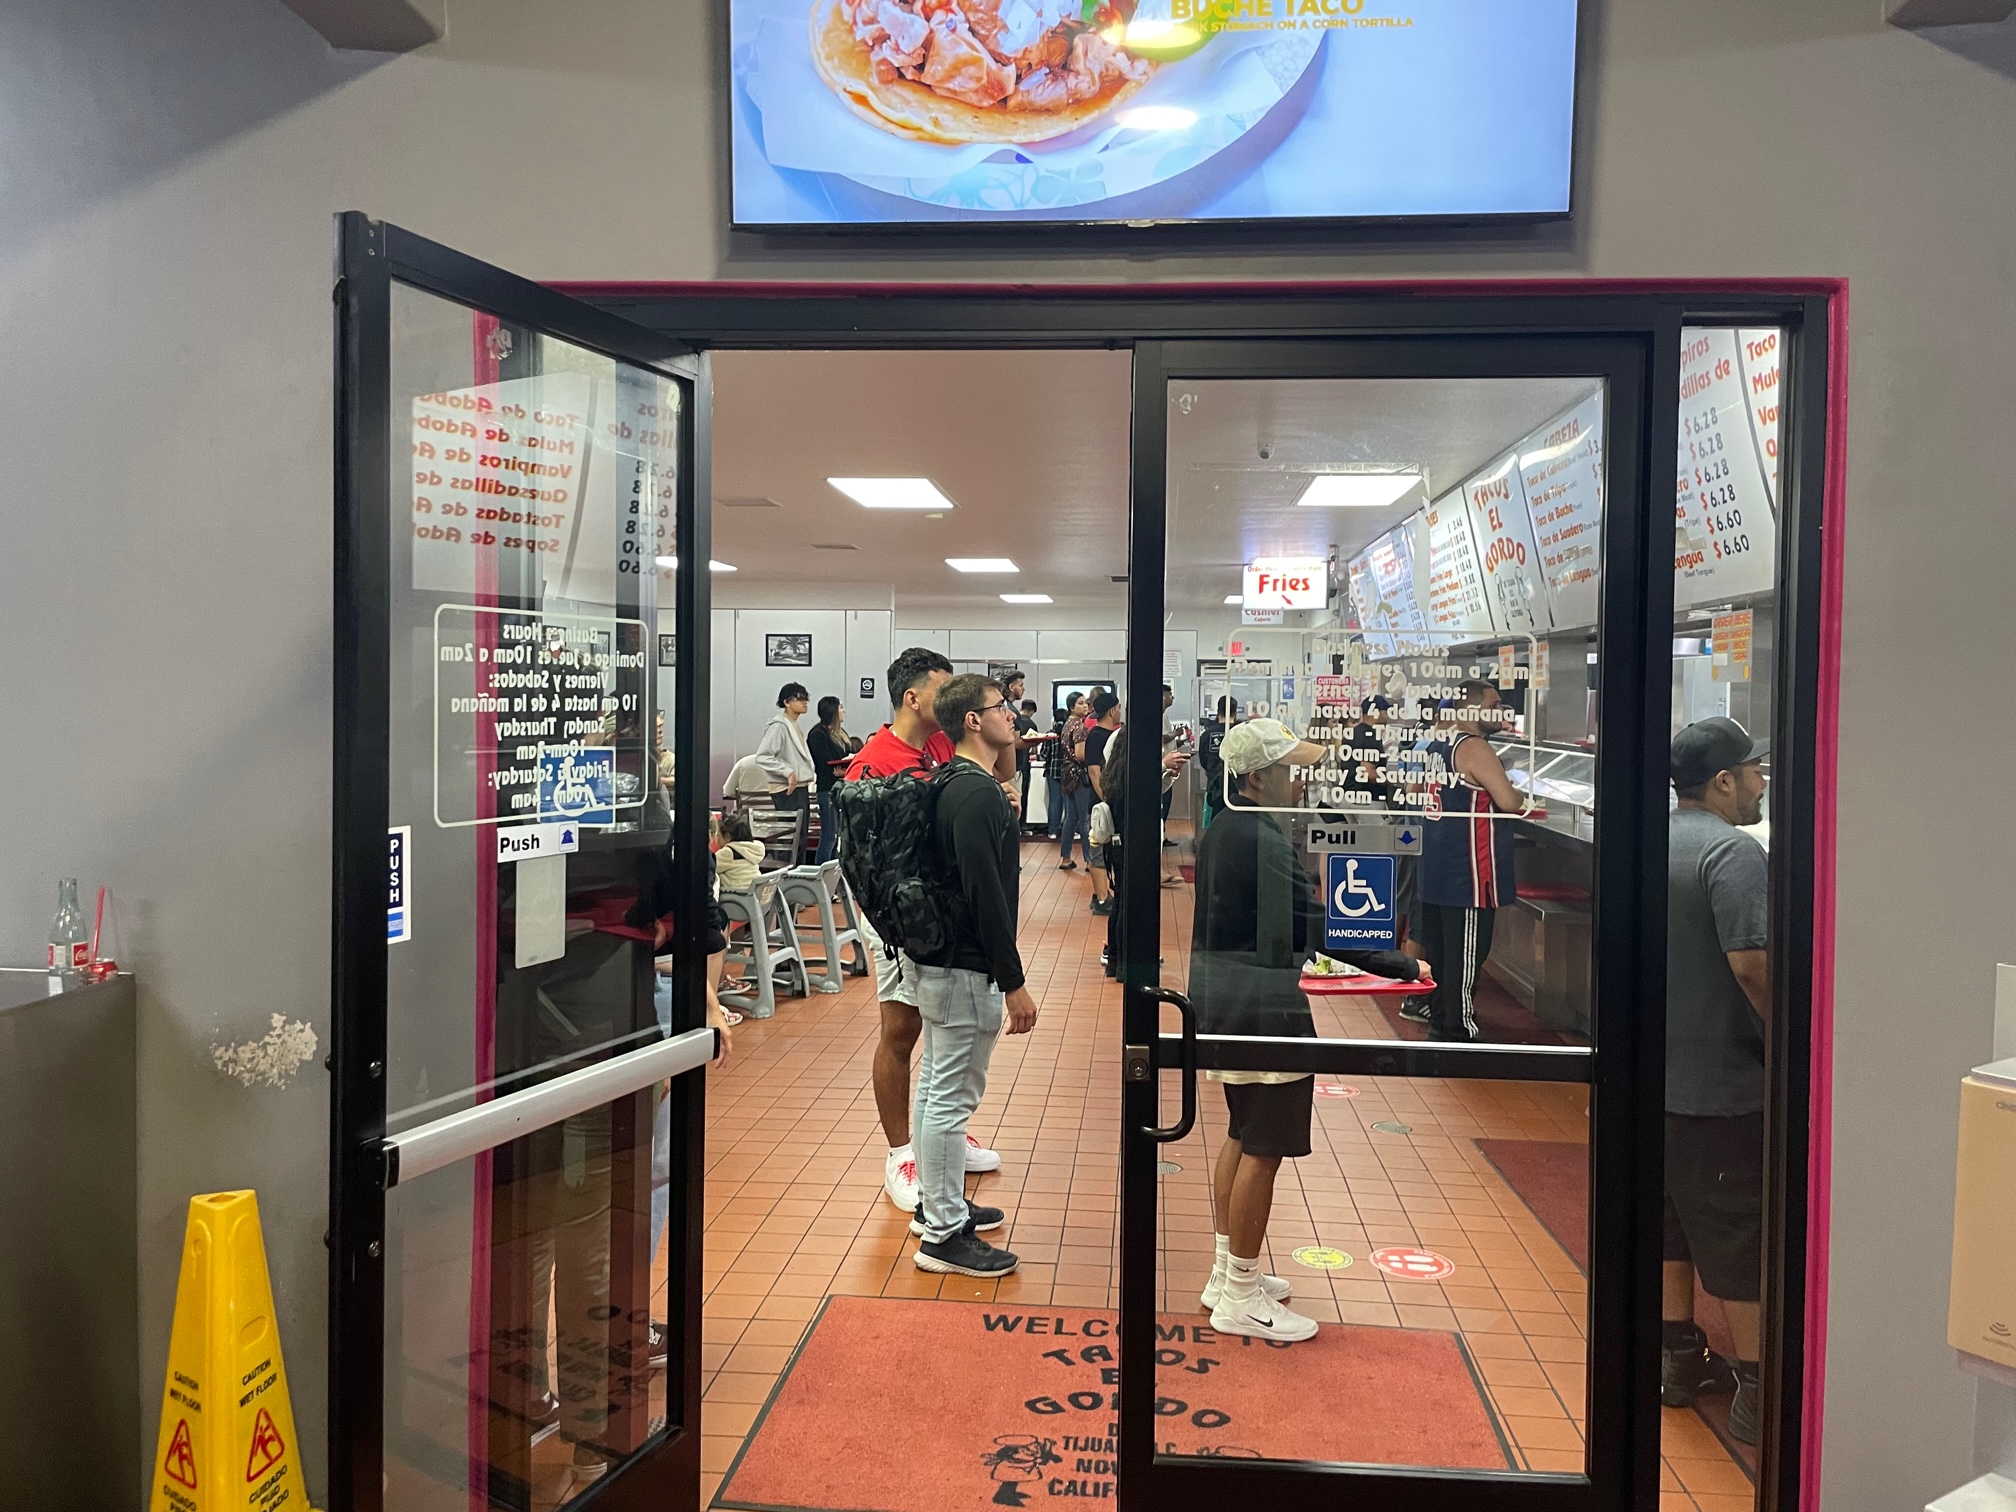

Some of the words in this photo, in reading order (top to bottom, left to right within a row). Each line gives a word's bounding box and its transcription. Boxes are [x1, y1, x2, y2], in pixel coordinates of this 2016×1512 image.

[1171, 0, 1275, 18] BUCHE
[1284, 0, 1365, 17] TACO
[1211, 20, 1274, 32] STOMACH
[1278, 20, 1297, 31] ON
[1299, 20, 1309, 30] A
[1312, 18, 1349, 29] CORN
[1353, 17, 1414, 28] TORTILLA
[1746, 333, 1777, 362] Taco
[1714, 358, 1731, 381] de
[1693, 406, 1719, 435] 6.28
[1698, 432, 1724, 459] 6.28
[1527, 475, 1539, 488] Taco
[1704, 458, 1730, 483] 6.28
[1474, 476, 1510, 512] TACOS
[1531, 495, 1543, 508] Taco
[1710, 483, 1736, 508] 6.28
[1488, 505, 1503, 533] EL
[1535, 515, 1547, 528] Taco
[1547, 509, 1555, 523] de
[1716, 509, 1742, 532] 6.60
[1540, 535, 1552, 548] Taco
[1551, 530, 1559, 543] de
[1723, 534, 1750, 556] 6.60
[1485, 537, 1527, 577] GORDO
[1544, 555, 1556, 568] Taco
[1556, 551, 1564, 564] de
[1258, 573, 1311, 595] Fries
[1396, 640, 1450, 658] Hours
[1409, 661, 1463, 679] 10am
[1468, 665, 1481, 678] a
[1487, 662, 1530, 680] 2am
[1246, 700, 1271, 718] 10
[1311, 699, 1361, 719] hasta
[1367, 702, 1380, 719] 4
[1415, 703, 1434, 721] la
[1440, 704, 1516, 722] mañana
[1327, 744, 1428, 763] 10am-2am
[1289, 764, 1350, 787] Friday
[1354, 766, 1370, 783] &
[1375, 766, 1467, 789] Saturday:
[1320, 786, 1373, 805] 10am
[1392, 788, 1436, 806] 4am
[499, 833, 541, 854] Push
[1311, 829, 1356, 845] Pull
[389, 838, 400, 904] PUSH
[1328, 929, 1393, 939] HANDICAPPED
[982, 1313, 1217, 1345] WELCME
[1042, 1344, 1221, 1375] TAOS
[242, 1357, 272, 1387] CAUTION
[239, 1388, 255, 1408] WET
[255, 1372, 278, 1396] FLOOR
[248, 1464, 289, 1505] CUIDADO
